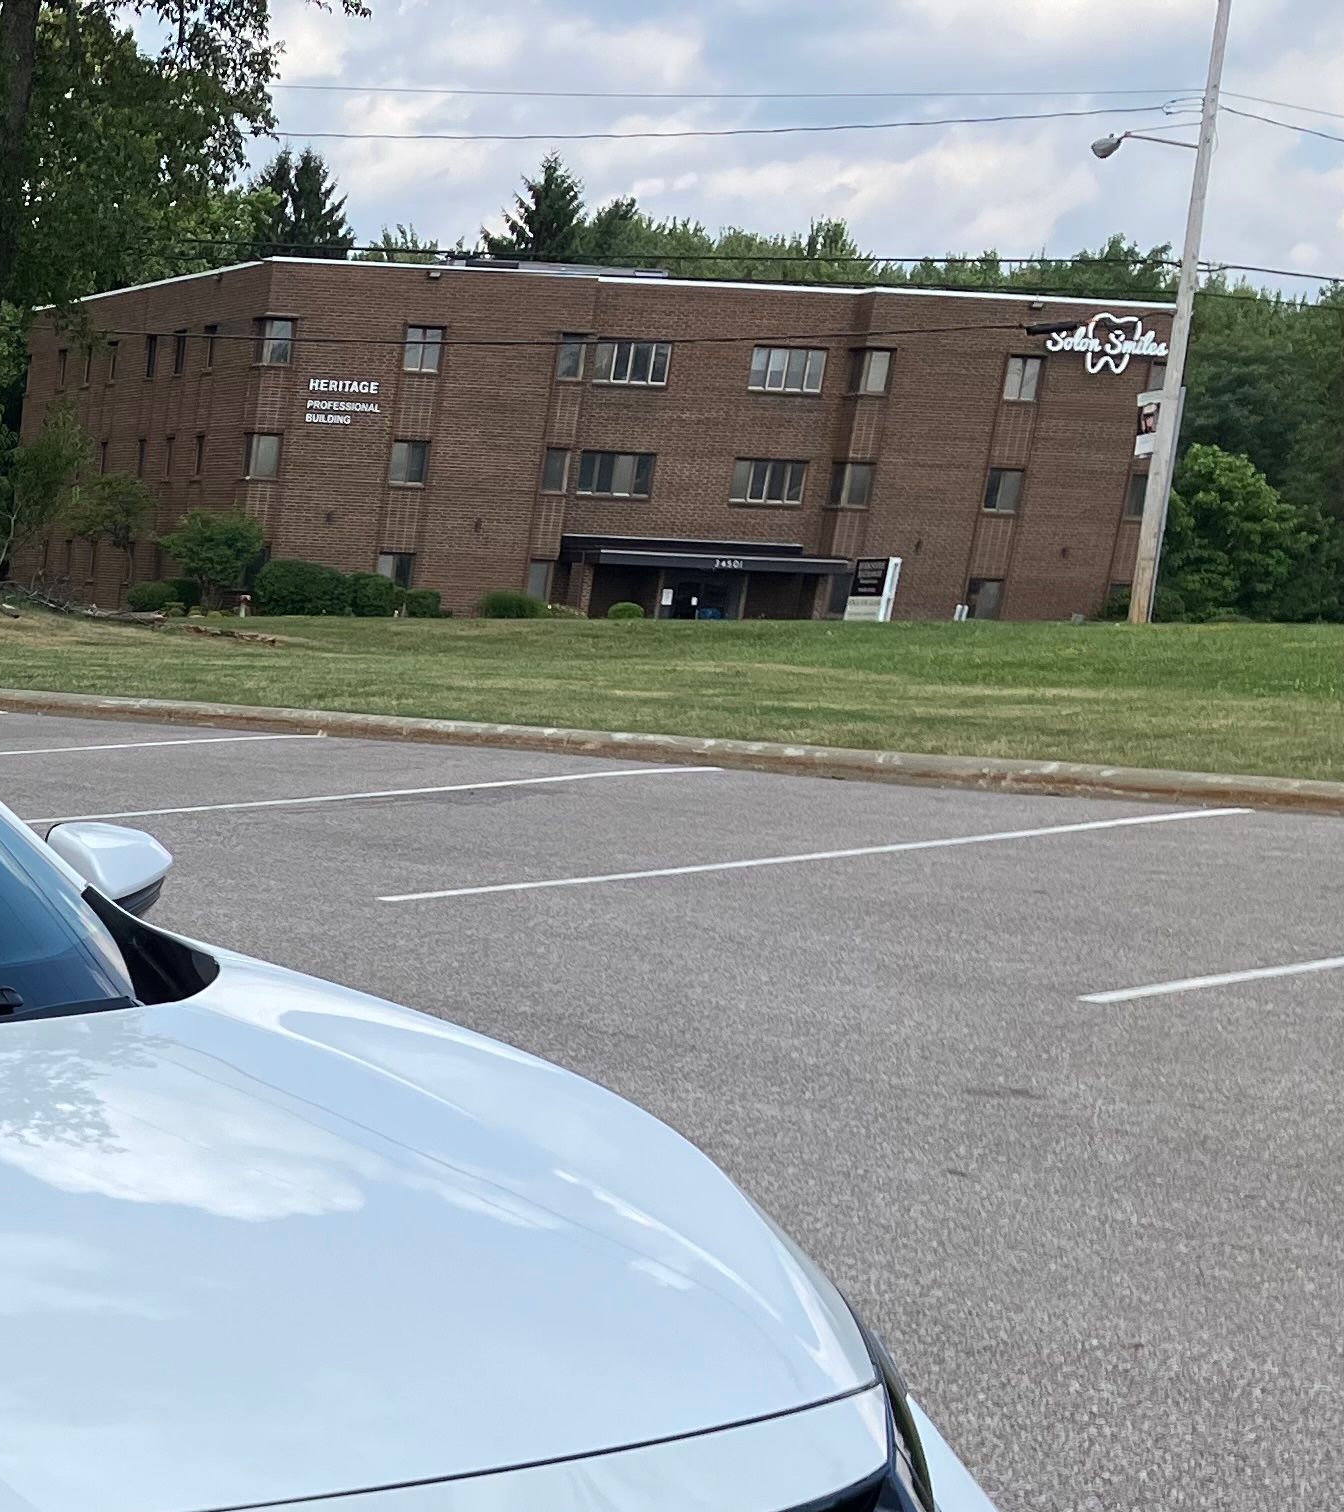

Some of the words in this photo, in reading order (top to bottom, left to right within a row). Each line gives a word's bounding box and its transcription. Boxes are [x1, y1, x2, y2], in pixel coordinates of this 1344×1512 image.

[1046, 326, 1102, 352] Solon
[1104, 329, 1169, 357] Smiles
[309, 378, 380, 394] HERITAGE
[306, 399, 381, 413] PROFESSIONAL
[305, 413, 351, 425] BUILDING
